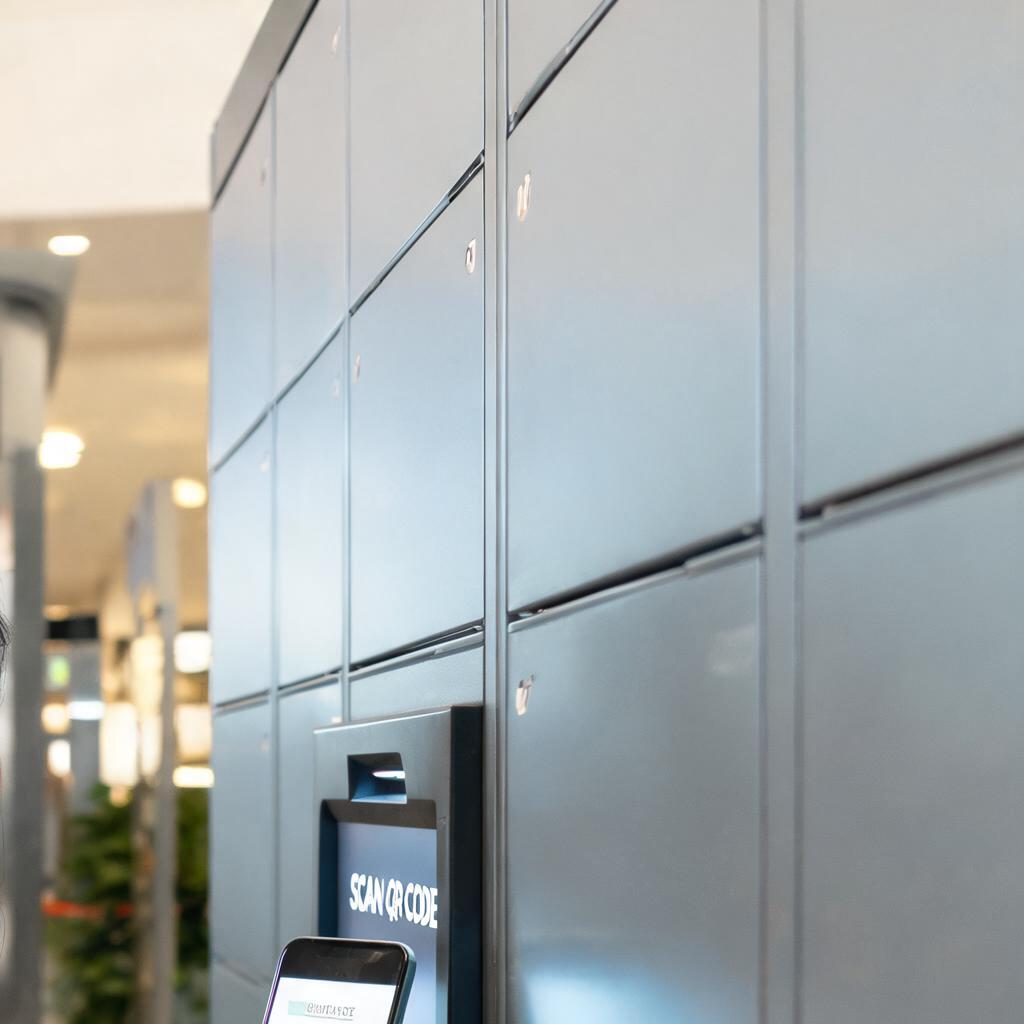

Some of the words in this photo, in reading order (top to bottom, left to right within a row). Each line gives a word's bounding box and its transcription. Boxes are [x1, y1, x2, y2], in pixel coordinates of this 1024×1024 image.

[349, 873, 384, 916] SCAN
[385, 879, 403, 922] QR
[404, 882, 437, 928] CODE
